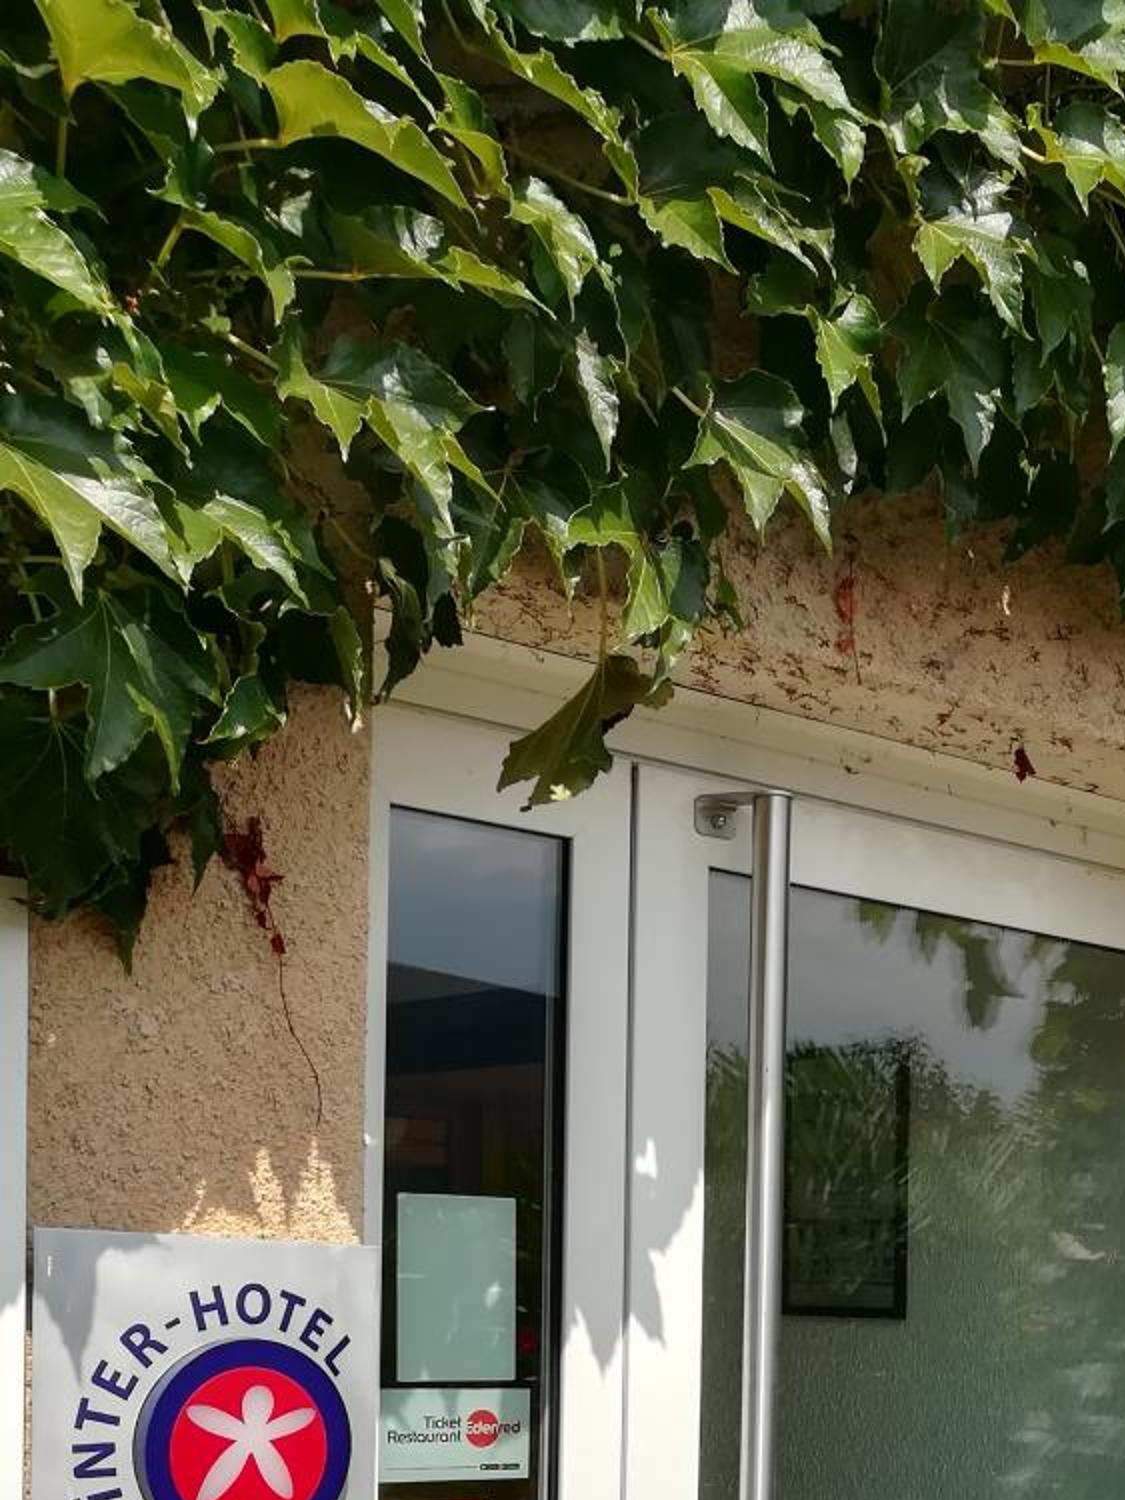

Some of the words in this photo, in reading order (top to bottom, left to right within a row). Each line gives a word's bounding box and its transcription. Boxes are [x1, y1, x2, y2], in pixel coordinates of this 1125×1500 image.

[424, 1415, 461, 1430] Ticket
[467, 1418, 520, 1435] Edenred
[388, 1431, 461, 1444] Restaurant
